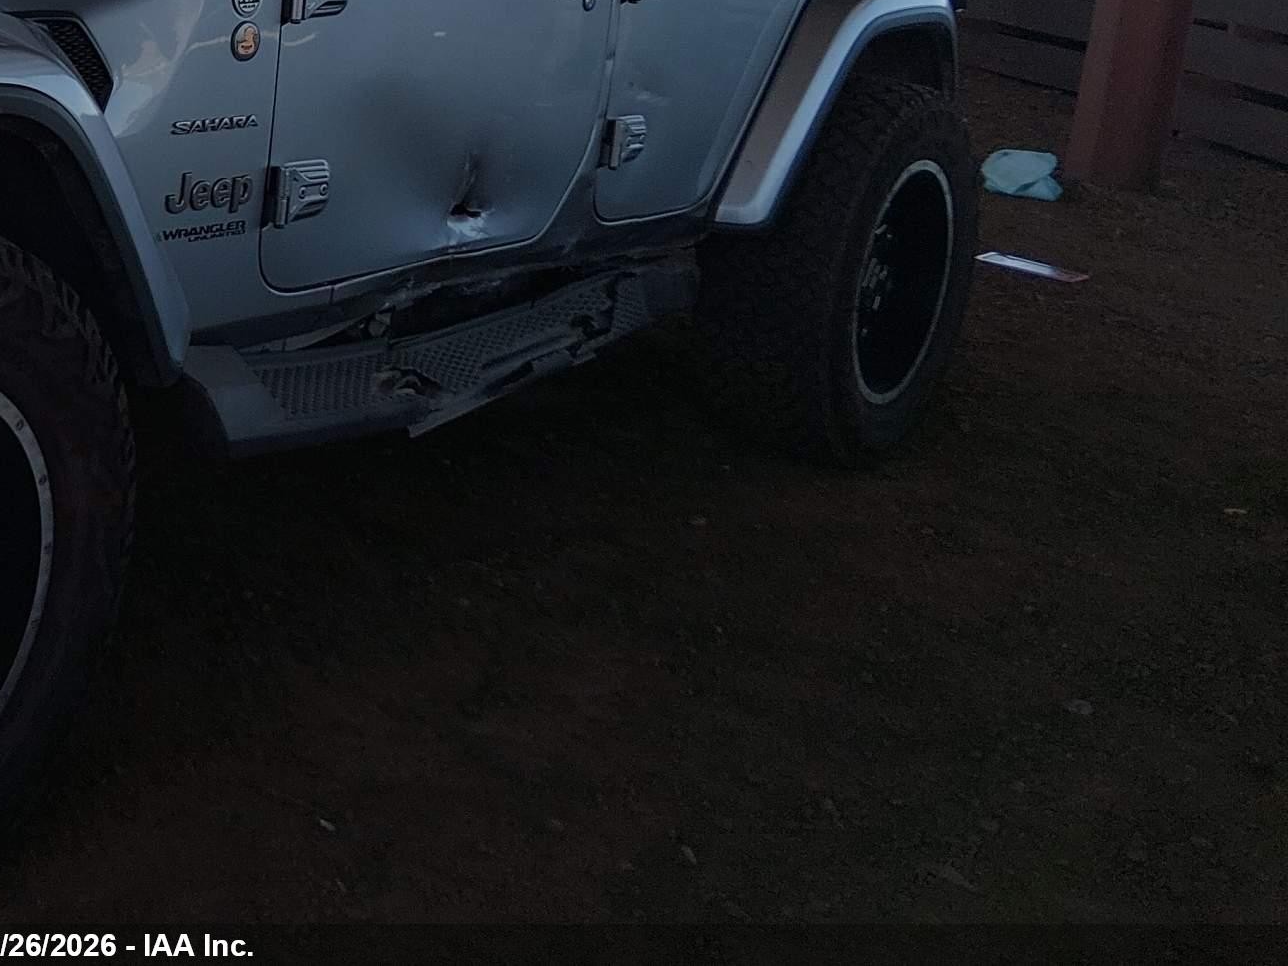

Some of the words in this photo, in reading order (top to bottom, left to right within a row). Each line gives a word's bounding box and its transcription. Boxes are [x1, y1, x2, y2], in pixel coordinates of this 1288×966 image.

[169, 114, 259, 135] SAHARA
[164, 171, 253, 215] Jeep
[162, 220, 247, 241] WRANGLER
